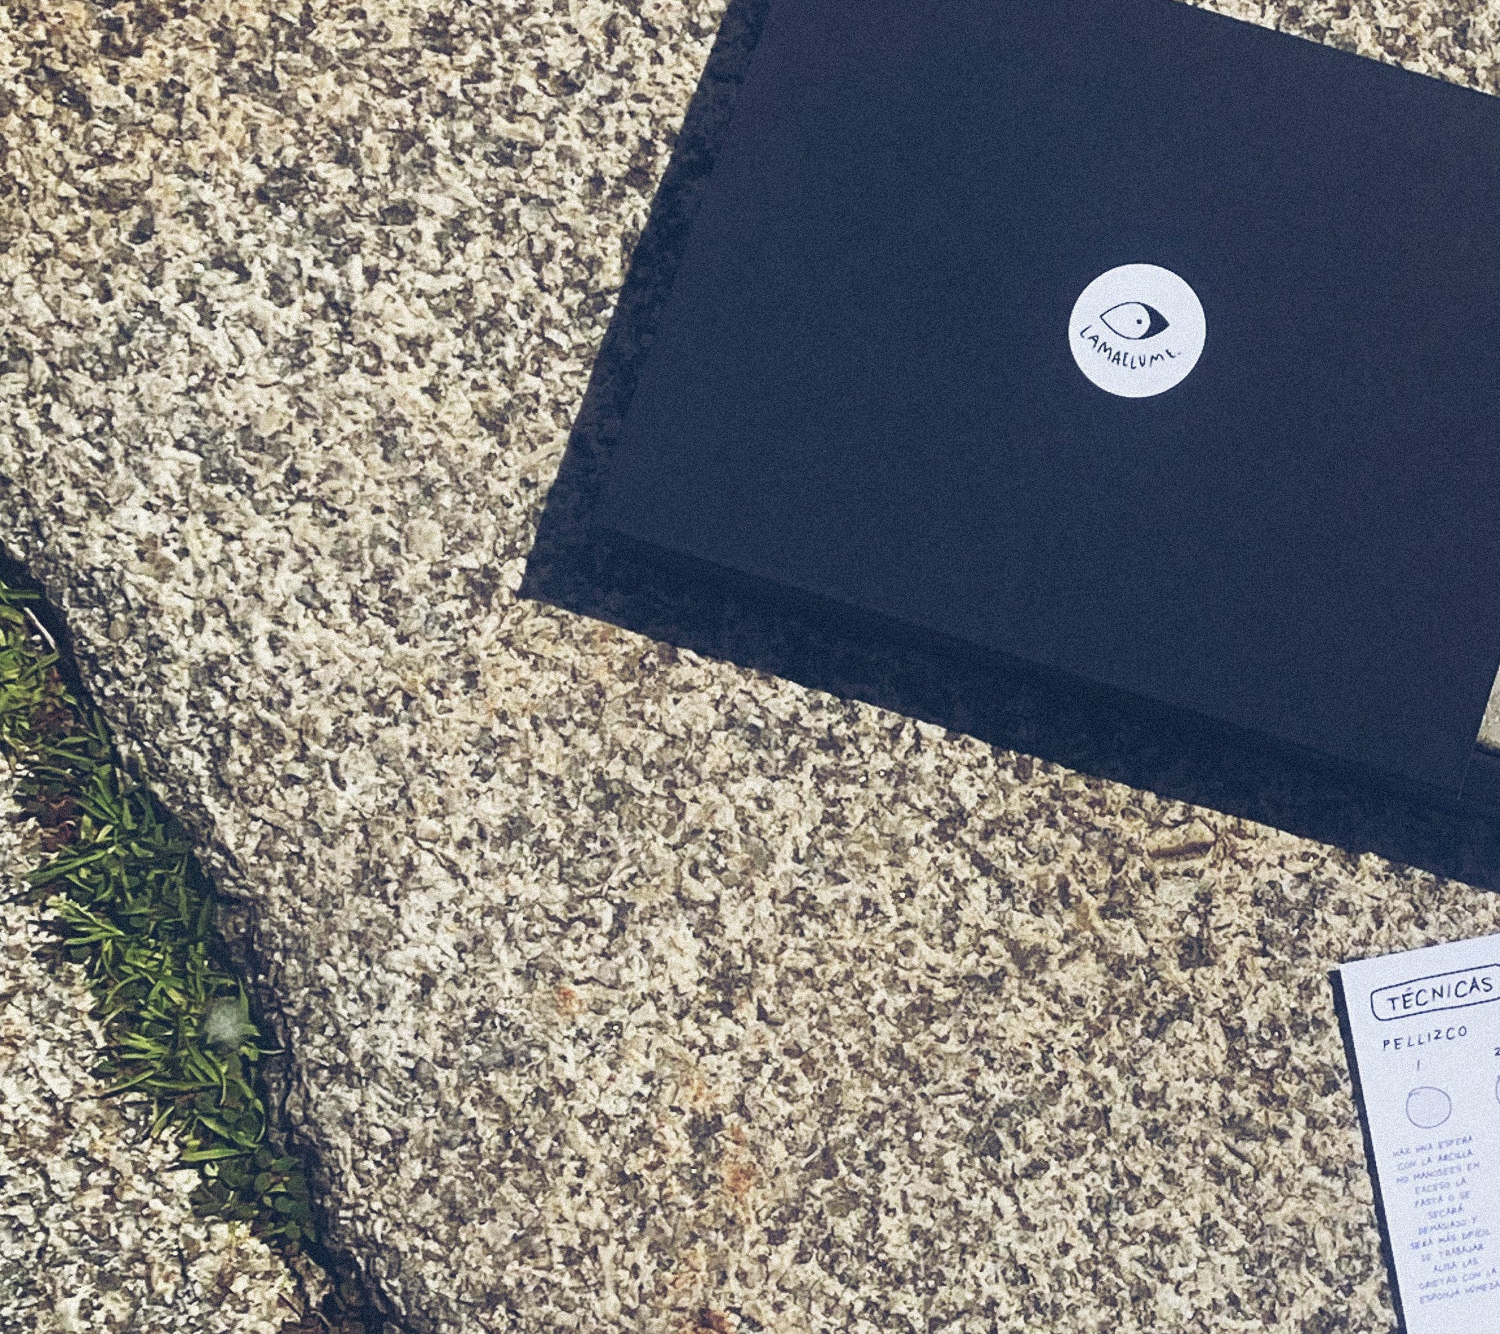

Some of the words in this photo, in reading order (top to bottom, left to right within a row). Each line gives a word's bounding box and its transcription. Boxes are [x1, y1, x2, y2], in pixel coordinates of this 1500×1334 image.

[1387, 976, 1493, 1010] TÉCNICAS
[1382, 1025, 1467, 1050] PELLIZCO
[1415, 1058, 1420, 1071] 1
